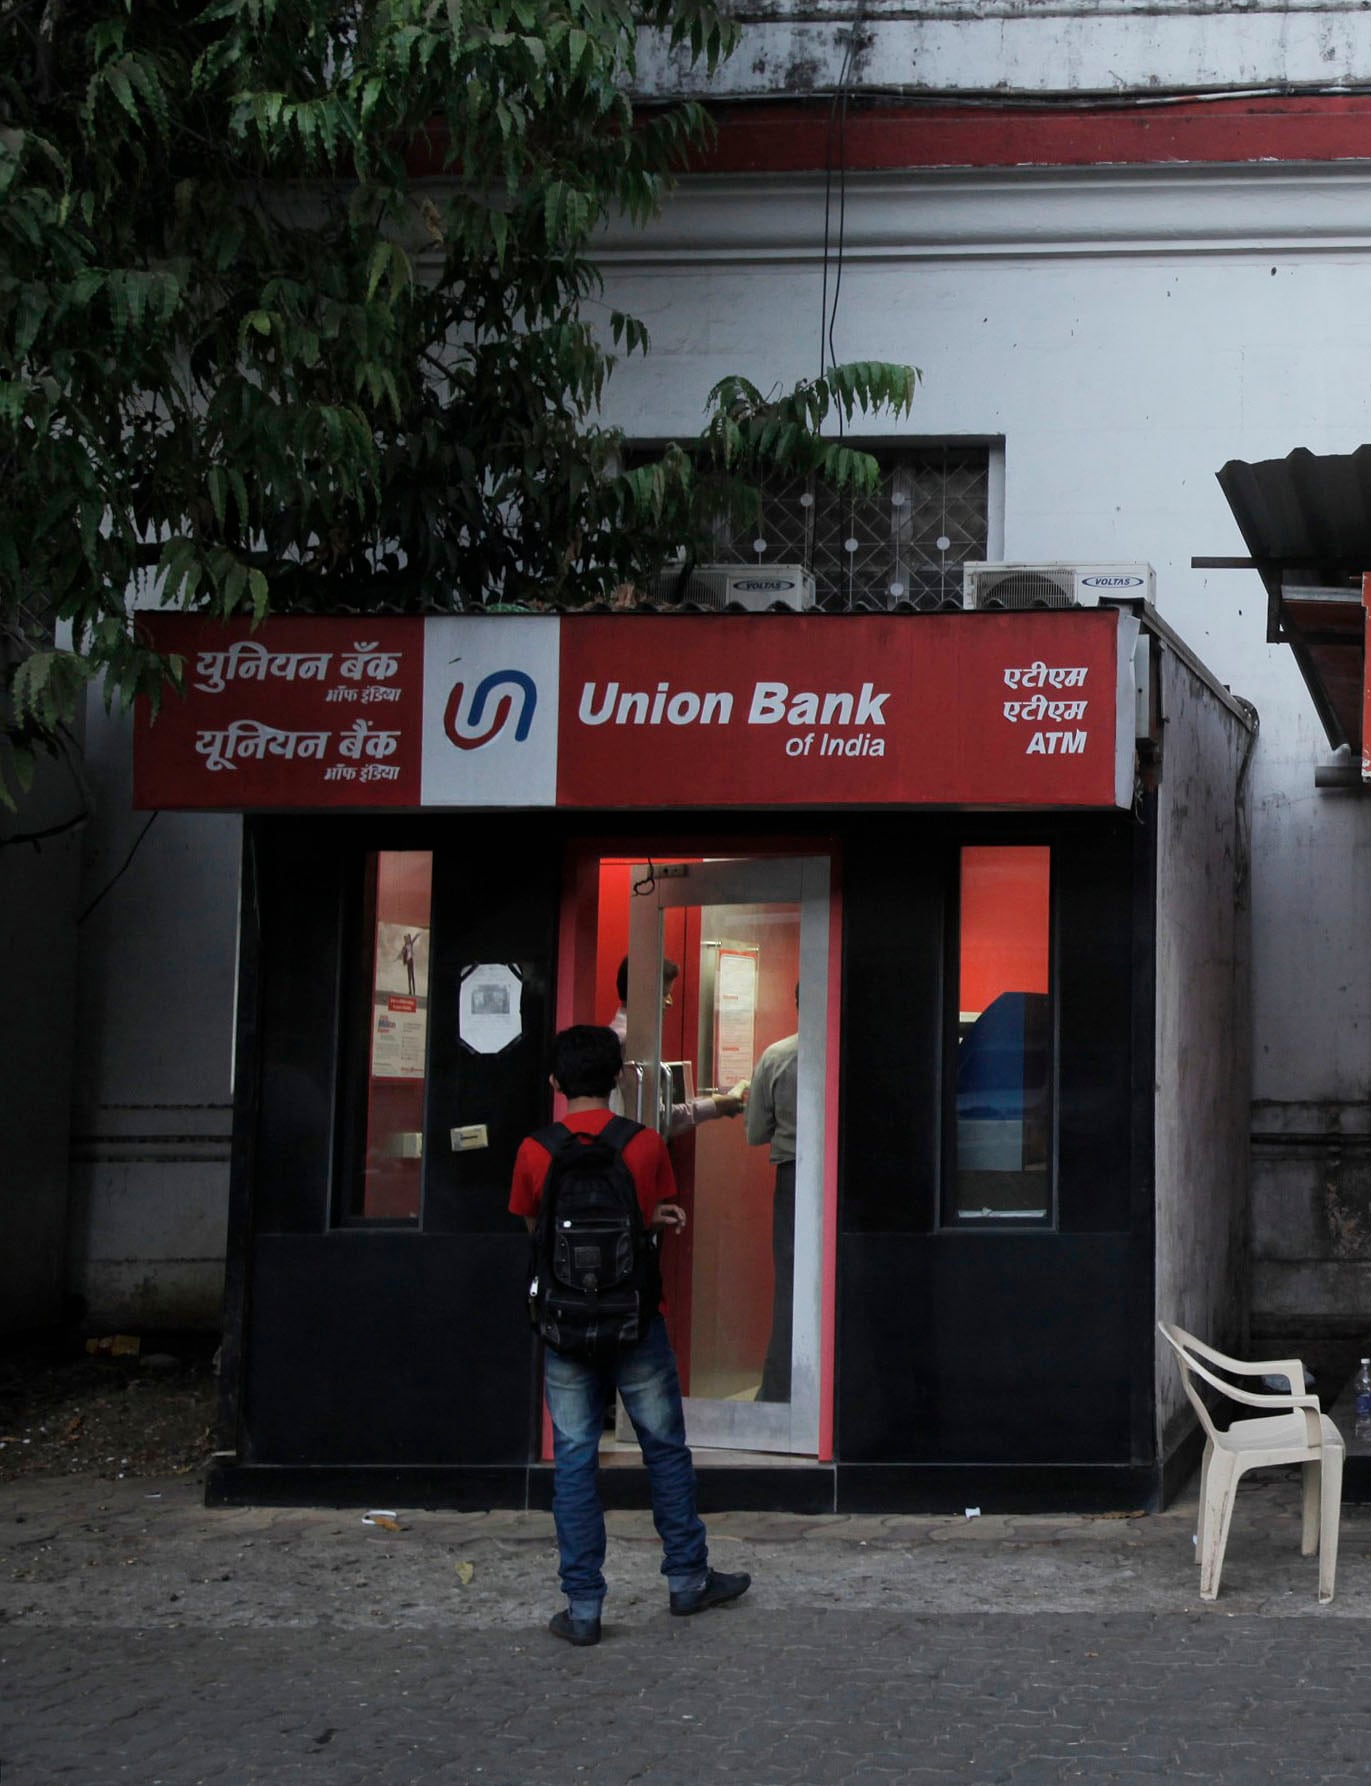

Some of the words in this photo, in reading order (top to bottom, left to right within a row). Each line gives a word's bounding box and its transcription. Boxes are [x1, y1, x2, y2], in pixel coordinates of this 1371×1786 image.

[746, 582, 781, 590] VOLTAS
[1095, 578, 1130, 586] VOLTAS
[194, 641, 334, 693] युनियन
[1003, 661, 1089, 690] एटीएम
[360, 685, 402, 704] इंडिया
[578, 682, 735, 726] Union
[747, 682, 891, 726] Bank
[1003, 694, 1089, 723] एटीएम
[194, 719, 333, 772] यूनियन
[338, 718, 402, 760] बैंक
[785, 733, 815, 757] of
[820, 733, 886, 757] India
[1025, 730, 1088, 755] ATM
[359, 763, 402, 783] इंडिया
